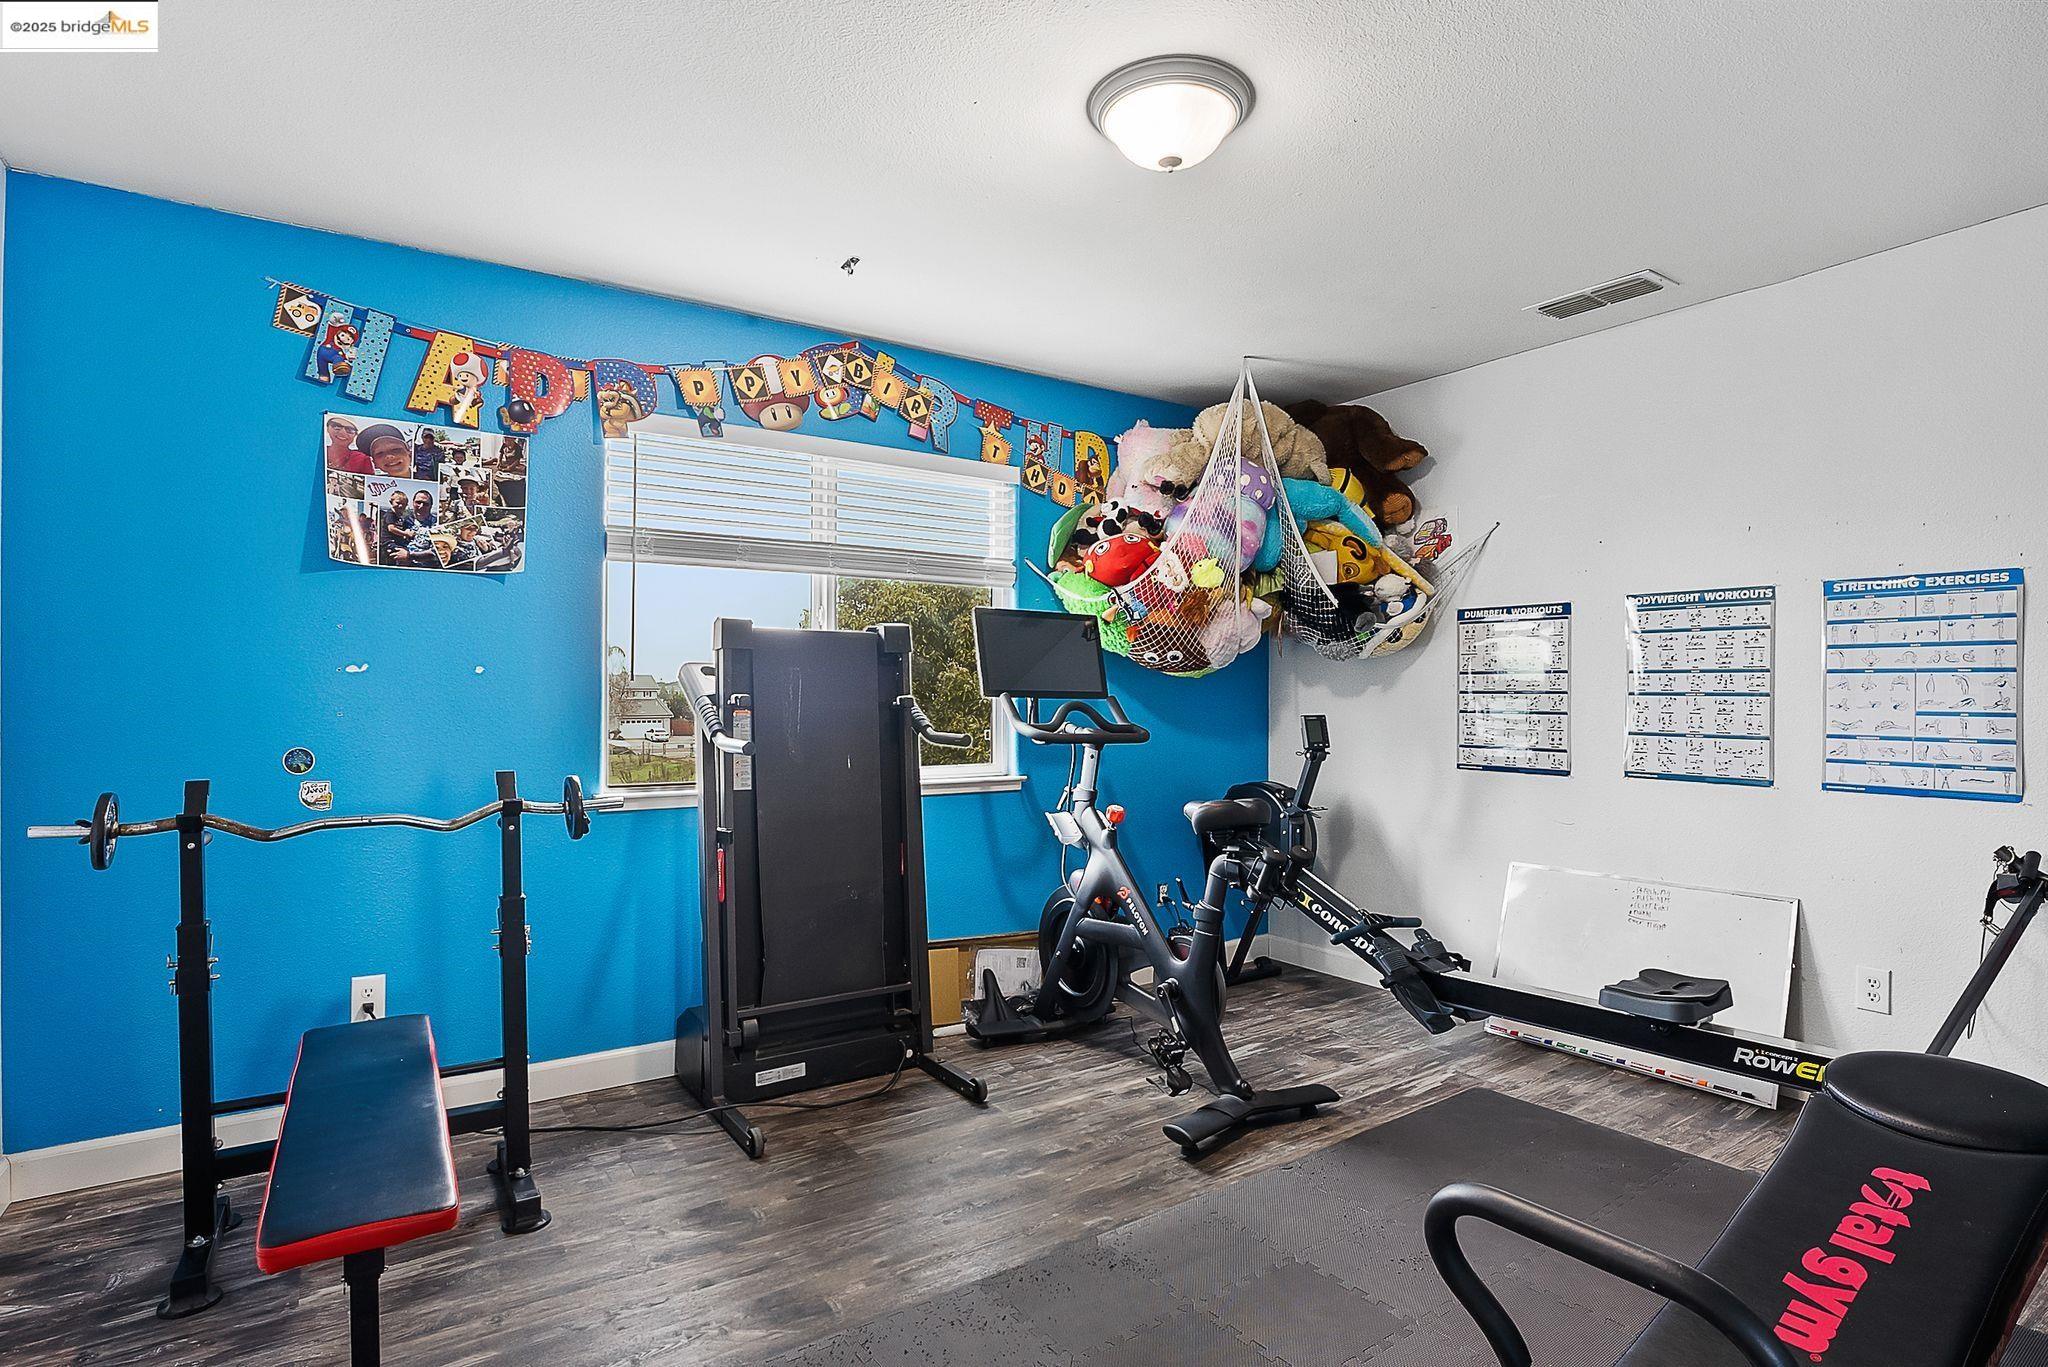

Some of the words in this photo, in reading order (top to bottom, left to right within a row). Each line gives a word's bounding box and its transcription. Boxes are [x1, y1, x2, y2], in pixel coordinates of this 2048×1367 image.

[1704, 588, 1774, 601] WORKOUTS
[1833, 577, 1920, 593] STRETCHING
[1925, 572, 2010, 587] EXERCISES
[1464, 608, 1509, 619] DUMBBELL
[1511, 605, 1563, 616] WORKOUTS
[1126, 897, 1149, 936] PELOTON
[1311, 903, 1377, 956] concpt
[1828, 1166, 1932, 1265] total
